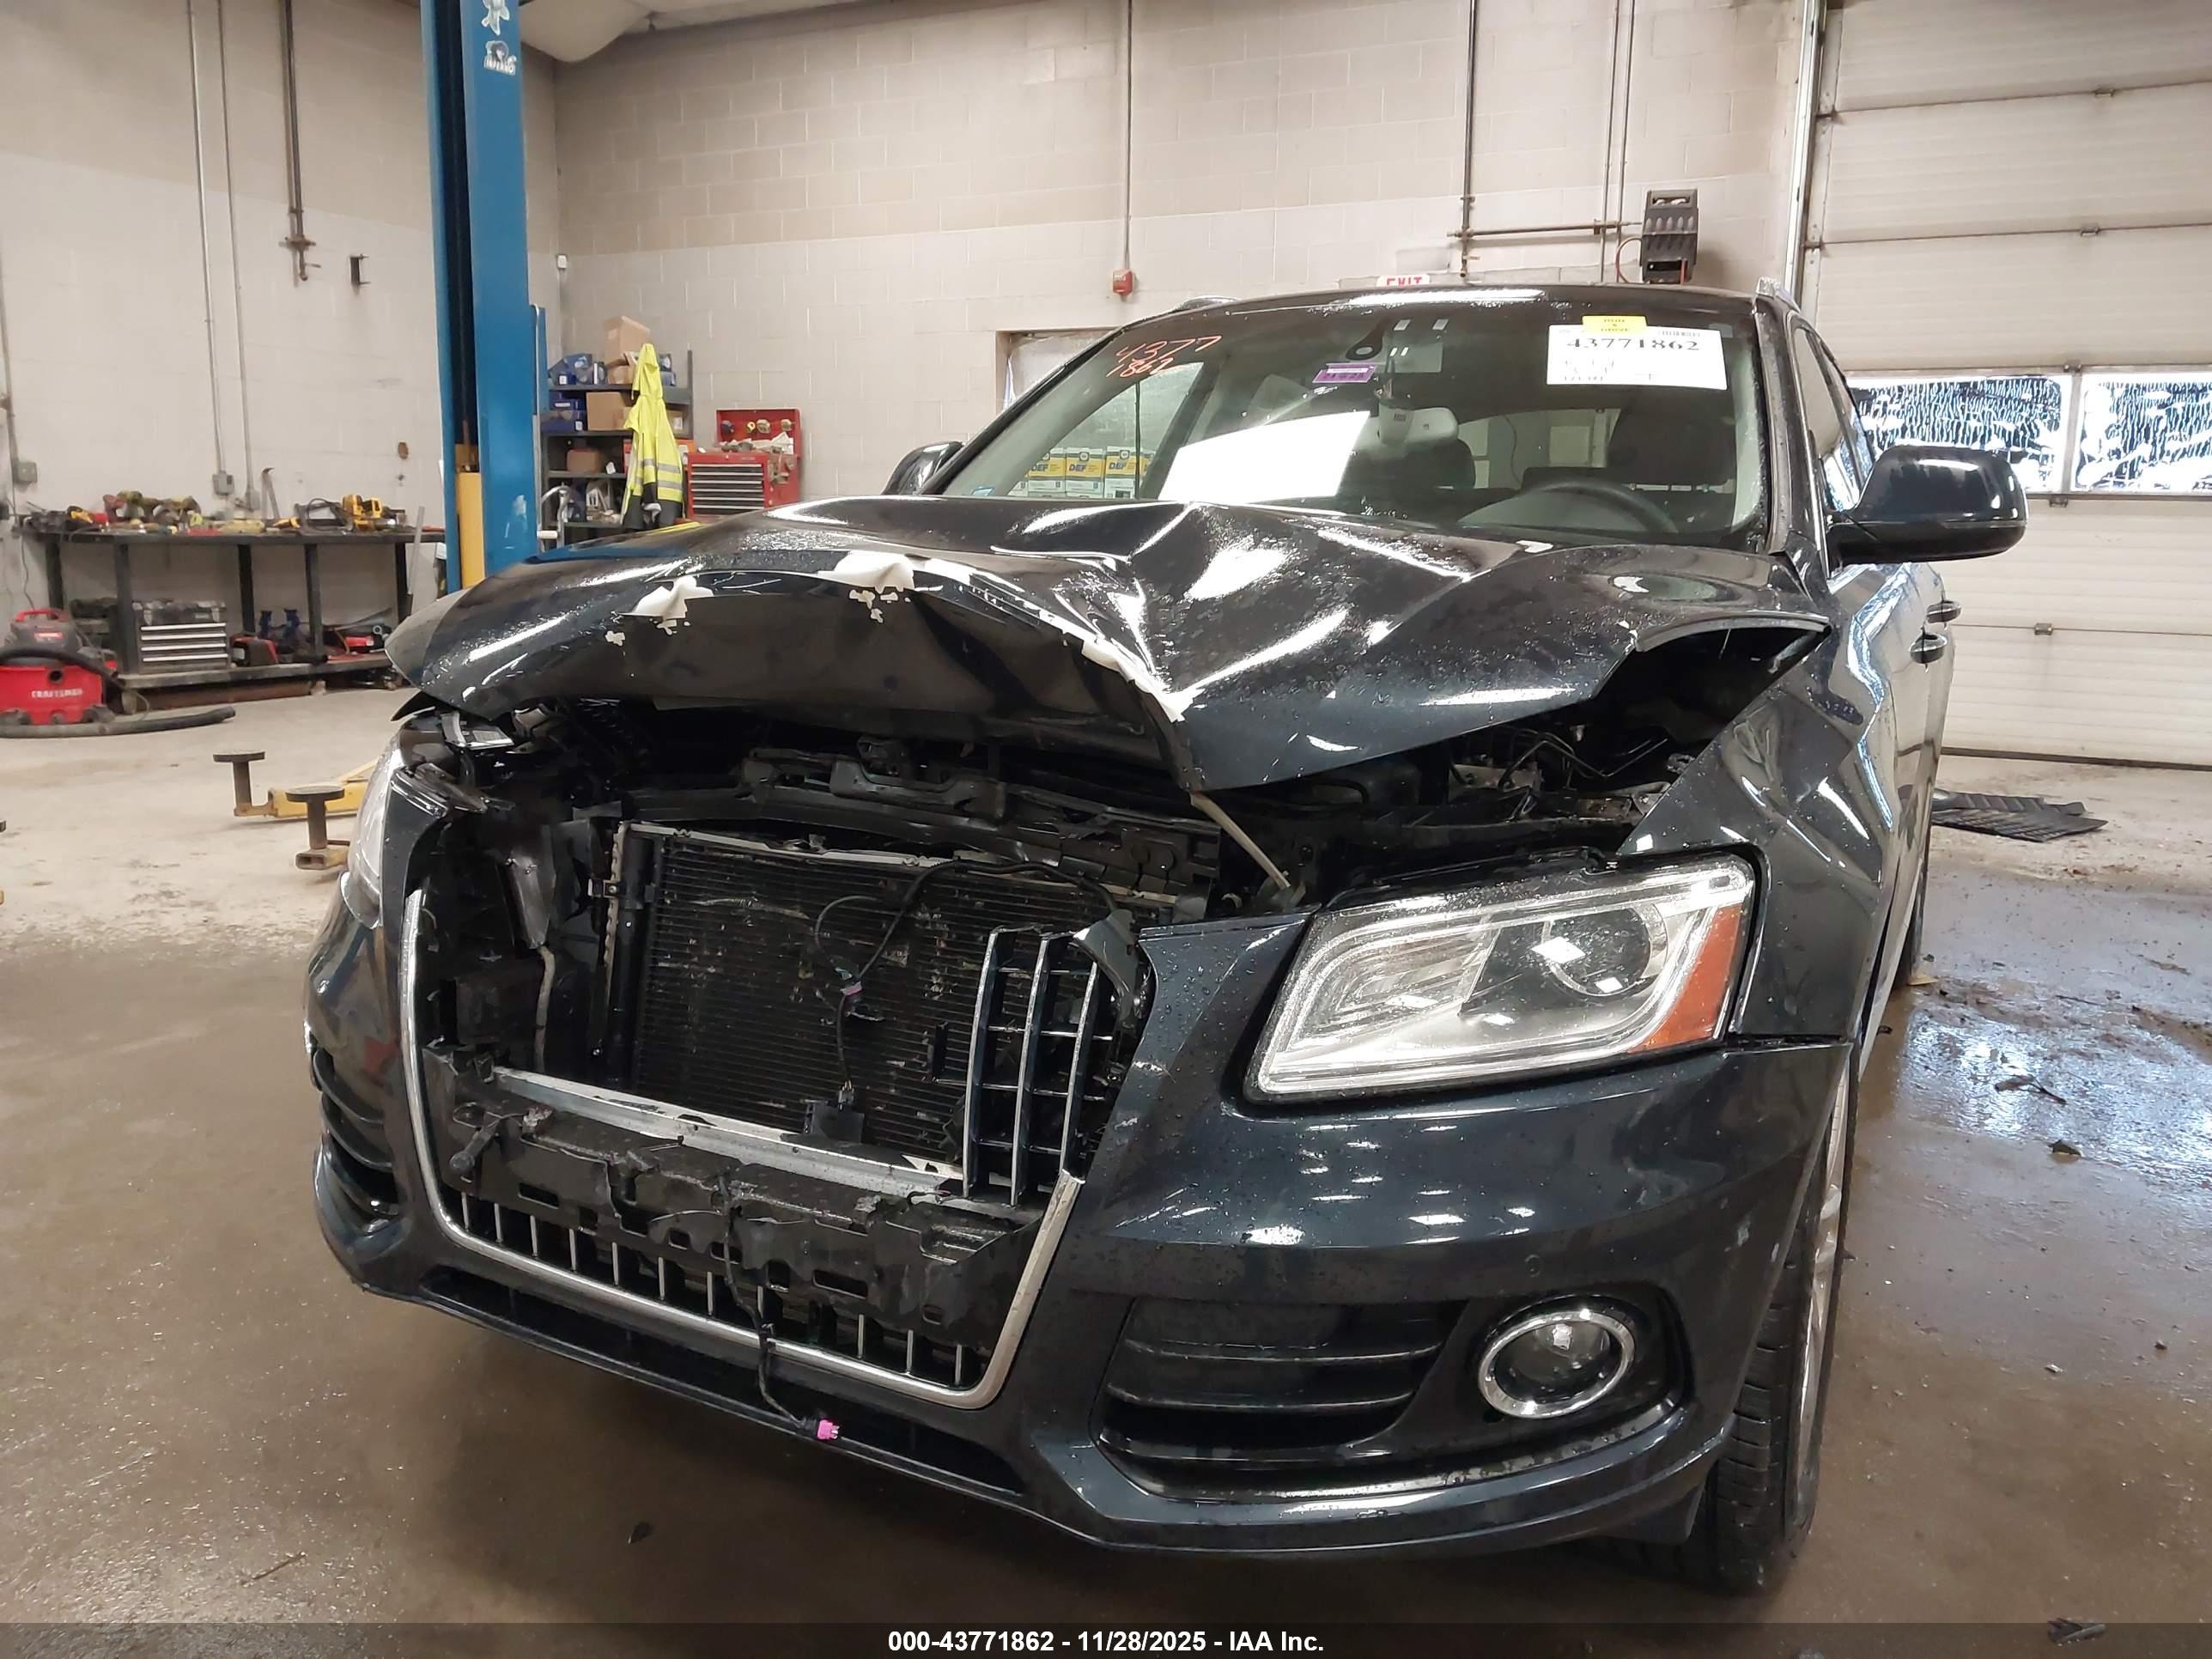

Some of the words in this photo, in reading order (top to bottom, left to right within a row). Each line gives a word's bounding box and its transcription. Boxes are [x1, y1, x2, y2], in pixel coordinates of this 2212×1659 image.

[1115, 335, 1222, 363] 4377
[1565, 337, 1700, 351] 43771862
[1106, 357, 1173, 377] 1862
